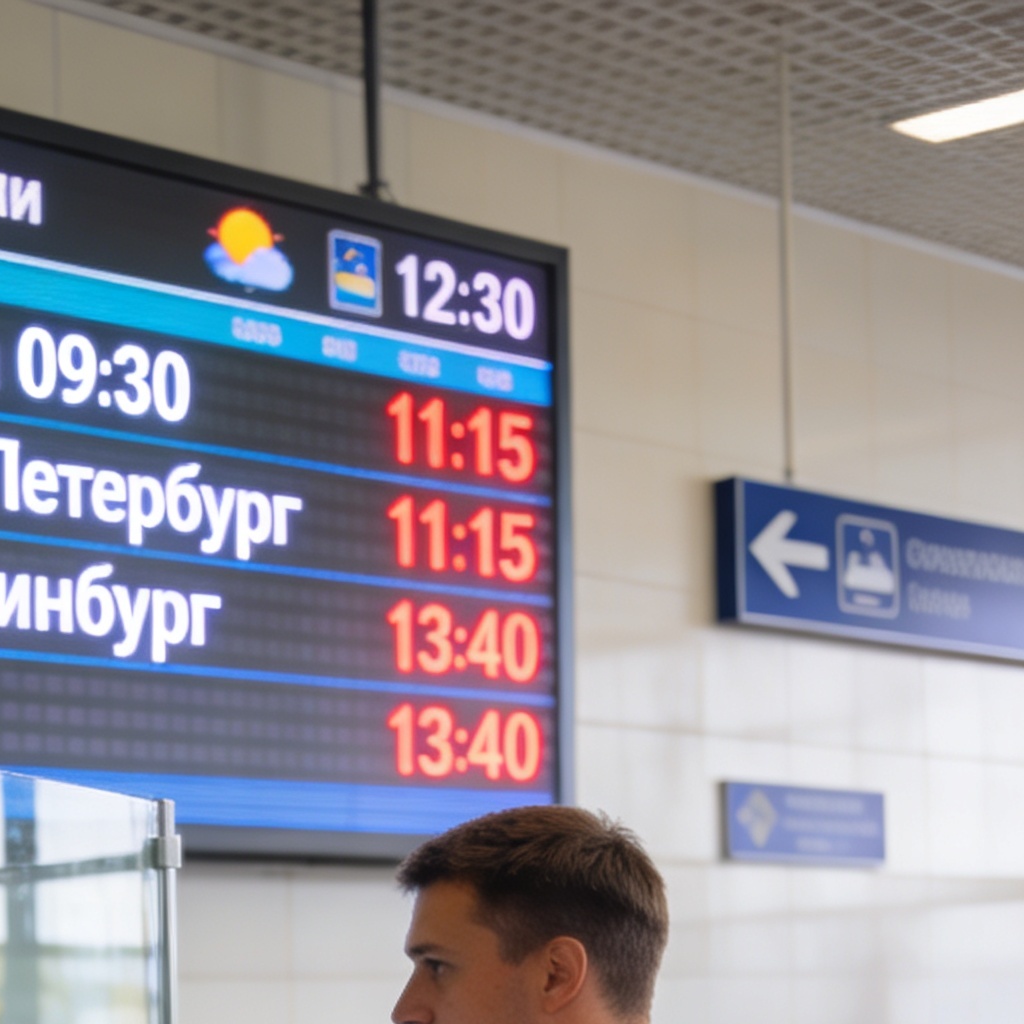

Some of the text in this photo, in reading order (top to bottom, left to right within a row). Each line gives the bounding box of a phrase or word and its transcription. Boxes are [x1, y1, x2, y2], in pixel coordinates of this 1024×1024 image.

[396, 254, 535, 341] 12:30
[17, 326, 191, 422] 09:30
[387, 391, 536, 483] 11:15
[387, 495, 537, 583] 11:15
[387, 599, 541, 684] 13:40
[387, 702, 543, 783] 13:40
